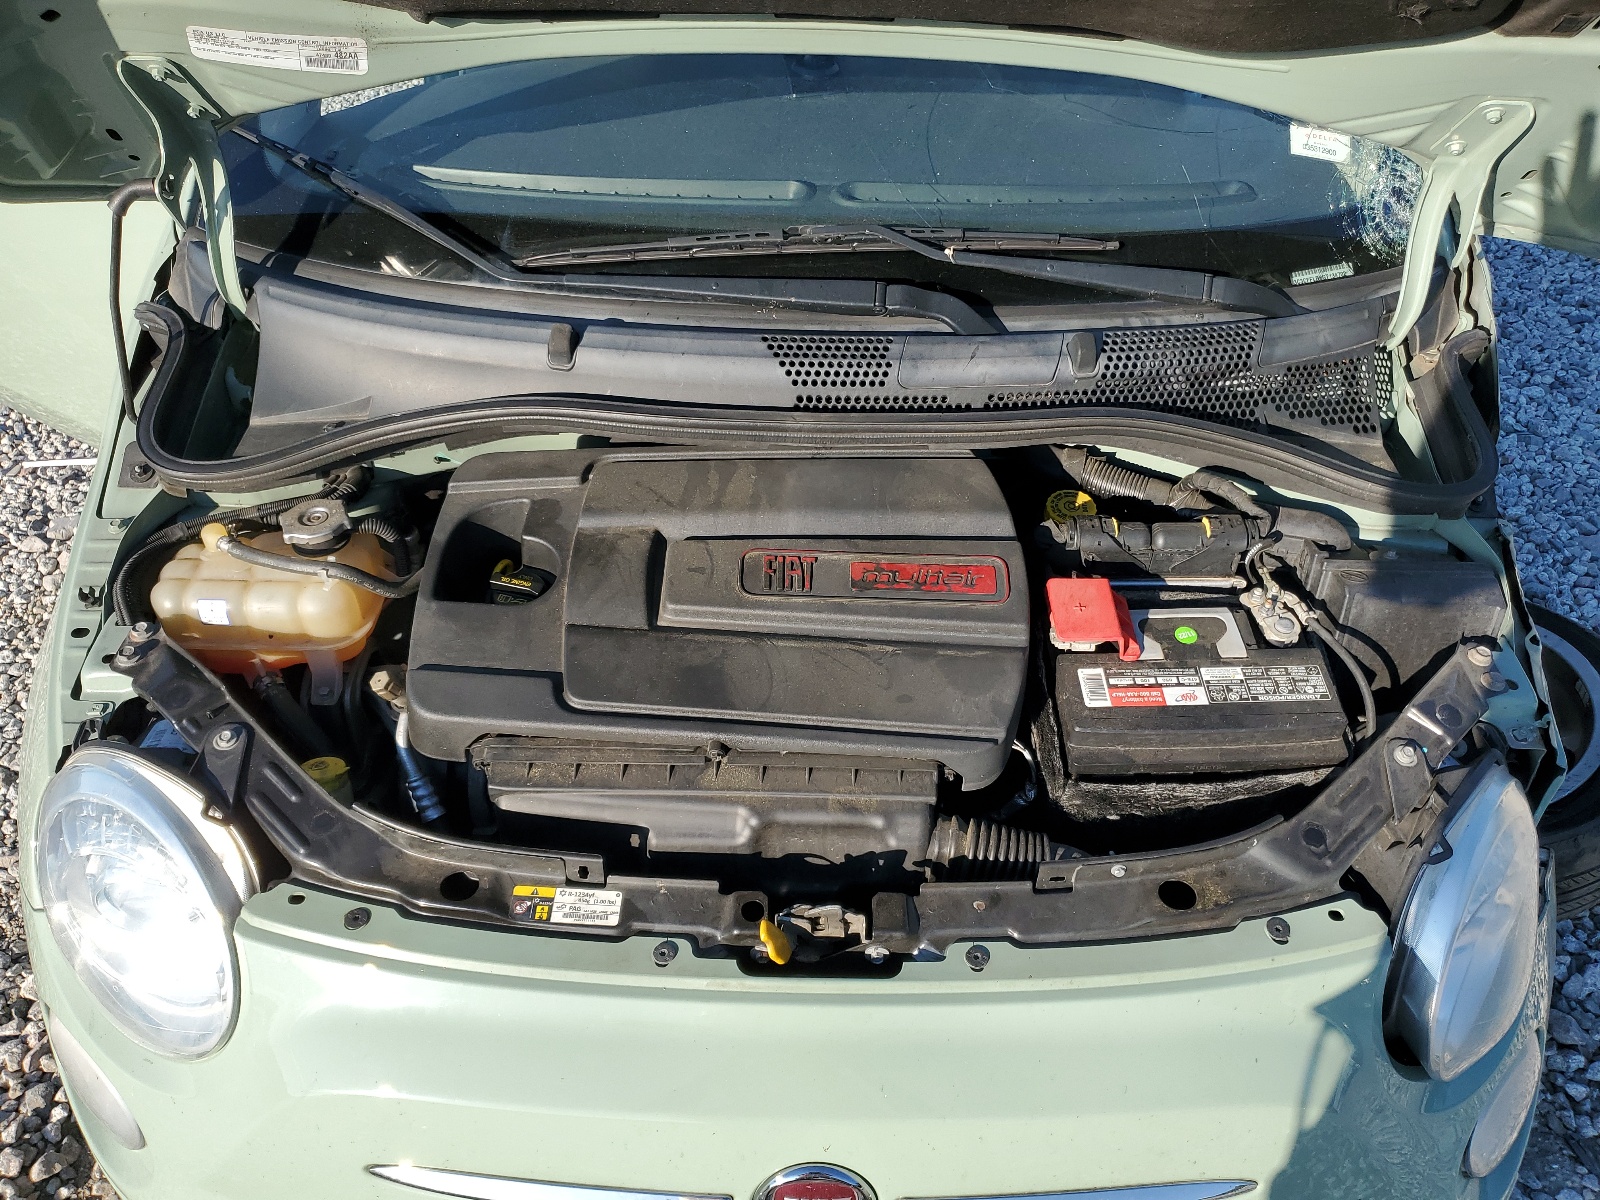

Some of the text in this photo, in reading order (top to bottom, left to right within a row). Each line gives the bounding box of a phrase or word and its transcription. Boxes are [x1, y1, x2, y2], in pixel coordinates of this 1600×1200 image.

[510, 578, 532, 587] ENGINE
[762, 555, 818, 592] FIAT
[862, 569, 986, 587] multiair
